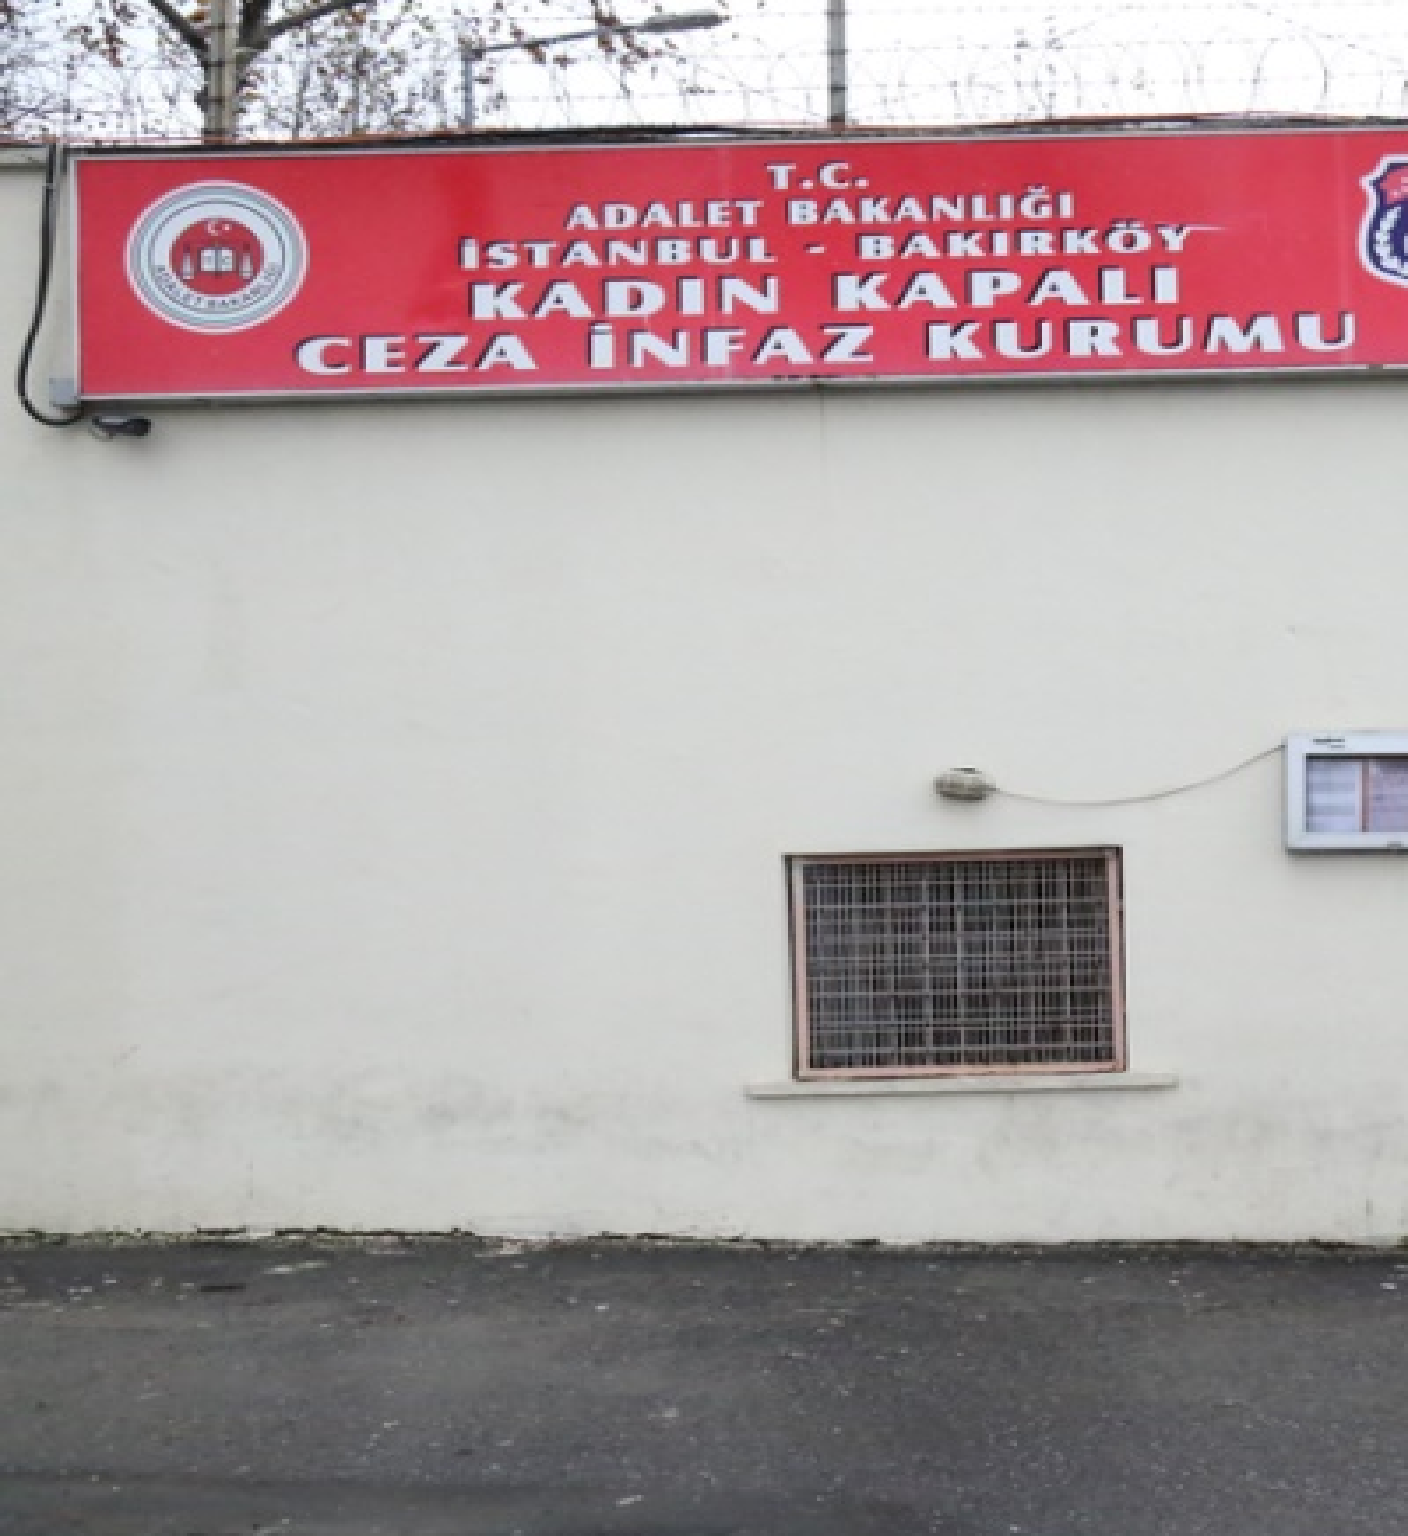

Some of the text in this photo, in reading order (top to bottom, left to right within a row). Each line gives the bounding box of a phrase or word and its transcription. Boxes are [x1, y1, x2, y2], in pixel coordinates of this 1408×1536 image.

[764, 162, 869, 191] T.C.
[565, 185, 1073, 232] ADALET BAKANLIĞI
[460, 237, 776, 270] İSTANBUL
[860, 222, 1192, 260] BAKIRKÖY
[468, 266, 1179, 322] KADIN KAPALI
[296, 313, 1357, 377] CEZA İNFAZ KURUMU
